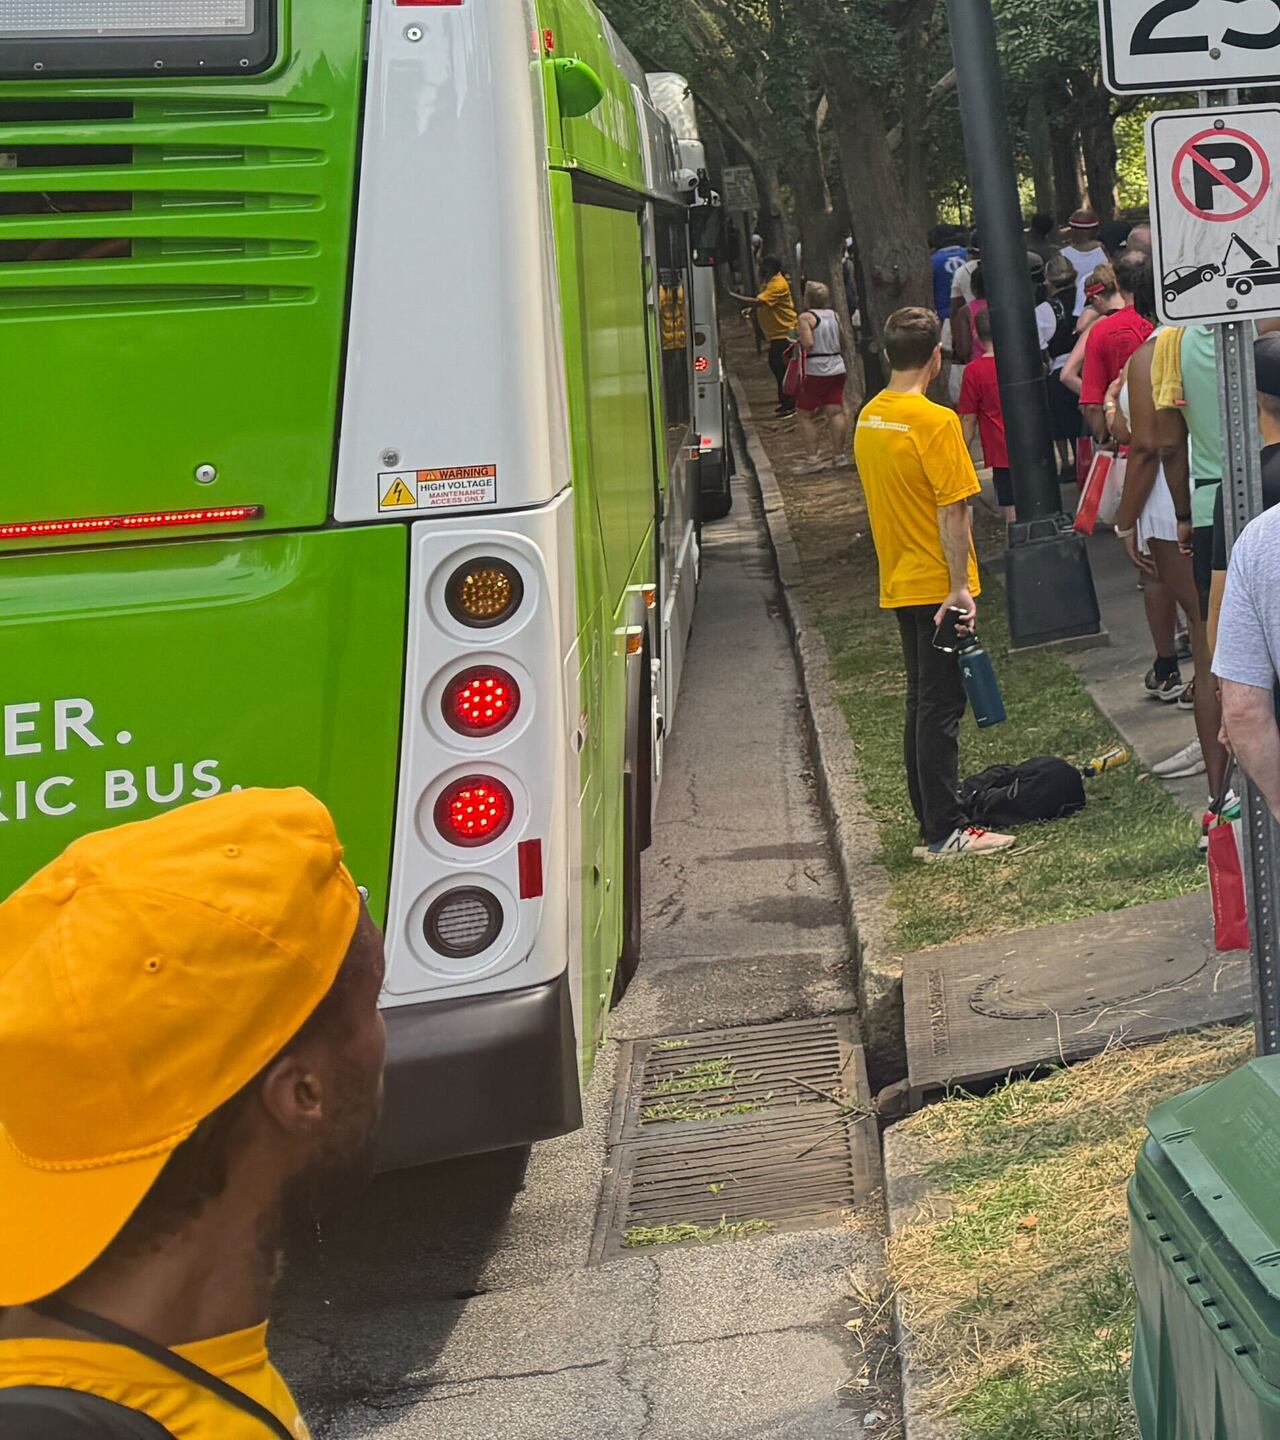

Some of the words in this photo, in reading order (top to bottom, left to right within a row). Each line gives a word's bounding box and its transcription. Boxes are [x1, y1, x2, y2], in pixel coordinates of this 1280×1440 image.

[1191, 141, 1254, 211] P
[439, 467, 489, 479] WARNING
[420, 481, 446, 492] HIGH
[447, 478, 493, 490] VOLTAGE
[428, 489, 486, 499] MAINTENANCE
[430, 497, 463, 505] ACCESS
[464, 495, 485, 503] ONLY
[0, 776, 77, 821] IC
